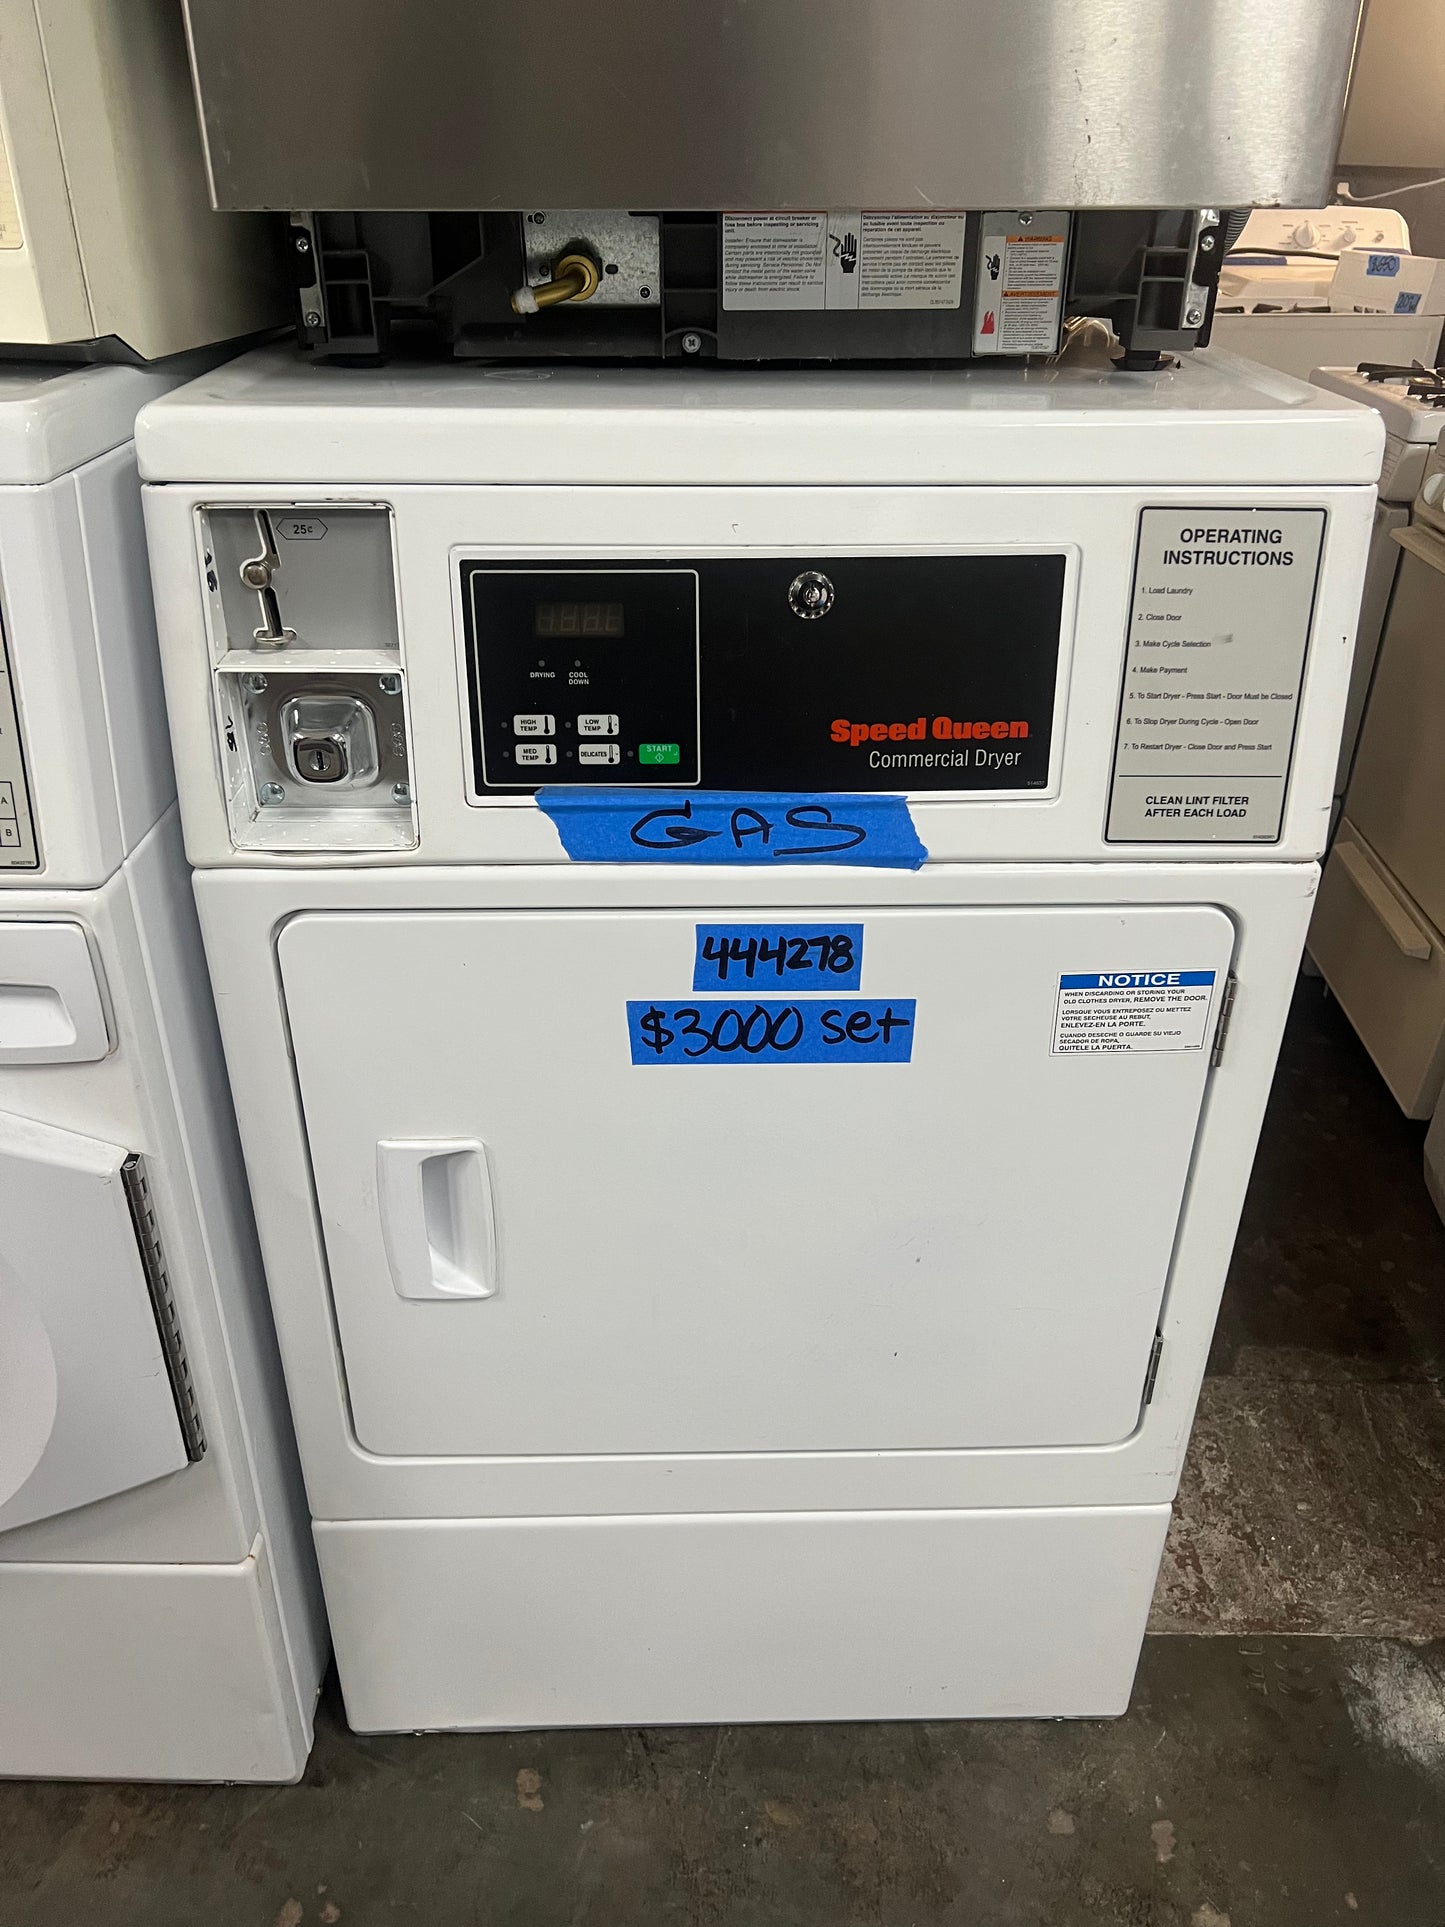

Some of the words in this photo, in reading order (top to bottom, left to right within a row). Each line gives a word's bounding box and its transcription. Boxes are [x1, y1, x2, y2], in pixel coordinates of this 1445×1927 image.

[1180, 528, 1283, 543] OPERATING
[1163, 550, 1294, 565] INSTRUCTIONS
[1167, 587, 1193, 595] Laundry
[1162, 640, 1180, 649] Cycle
[1159, 667, 1187, 675] Payment
[1164, 693, 1180, 701] Dryer
[1144, 718, 1158, 726] Stop
[1160, 718, 1177, 726] Dryer
[1179, 718, 1199, 726] During
[830, 717, 927, 747] Speed
[932, 716, 1029, 740] Queen
[1165, 744, 1182, 752] Dryer
[869, 750, 968, 768] Commercial
[975, 749, 1022, 770] Dryer
[1145, 797, 1183, 805] CLEAN
[1186, 797, 1210, 805] LINT
[1212, 797, 1249, 805] FILTER
[1144, 809, 1180, 817] AFTER
[1184, 809, 1214, 817] EACH
[1216, 809, 1246, 817] LOAD
[630, 799, 867, 856] GAS
[702, 935, 854, 979] 444278
[1098, 974, 1181, 986] NOTICE
[640, 1004, 803, 1056] $3000
[821, 1007, 910, 1045] set
